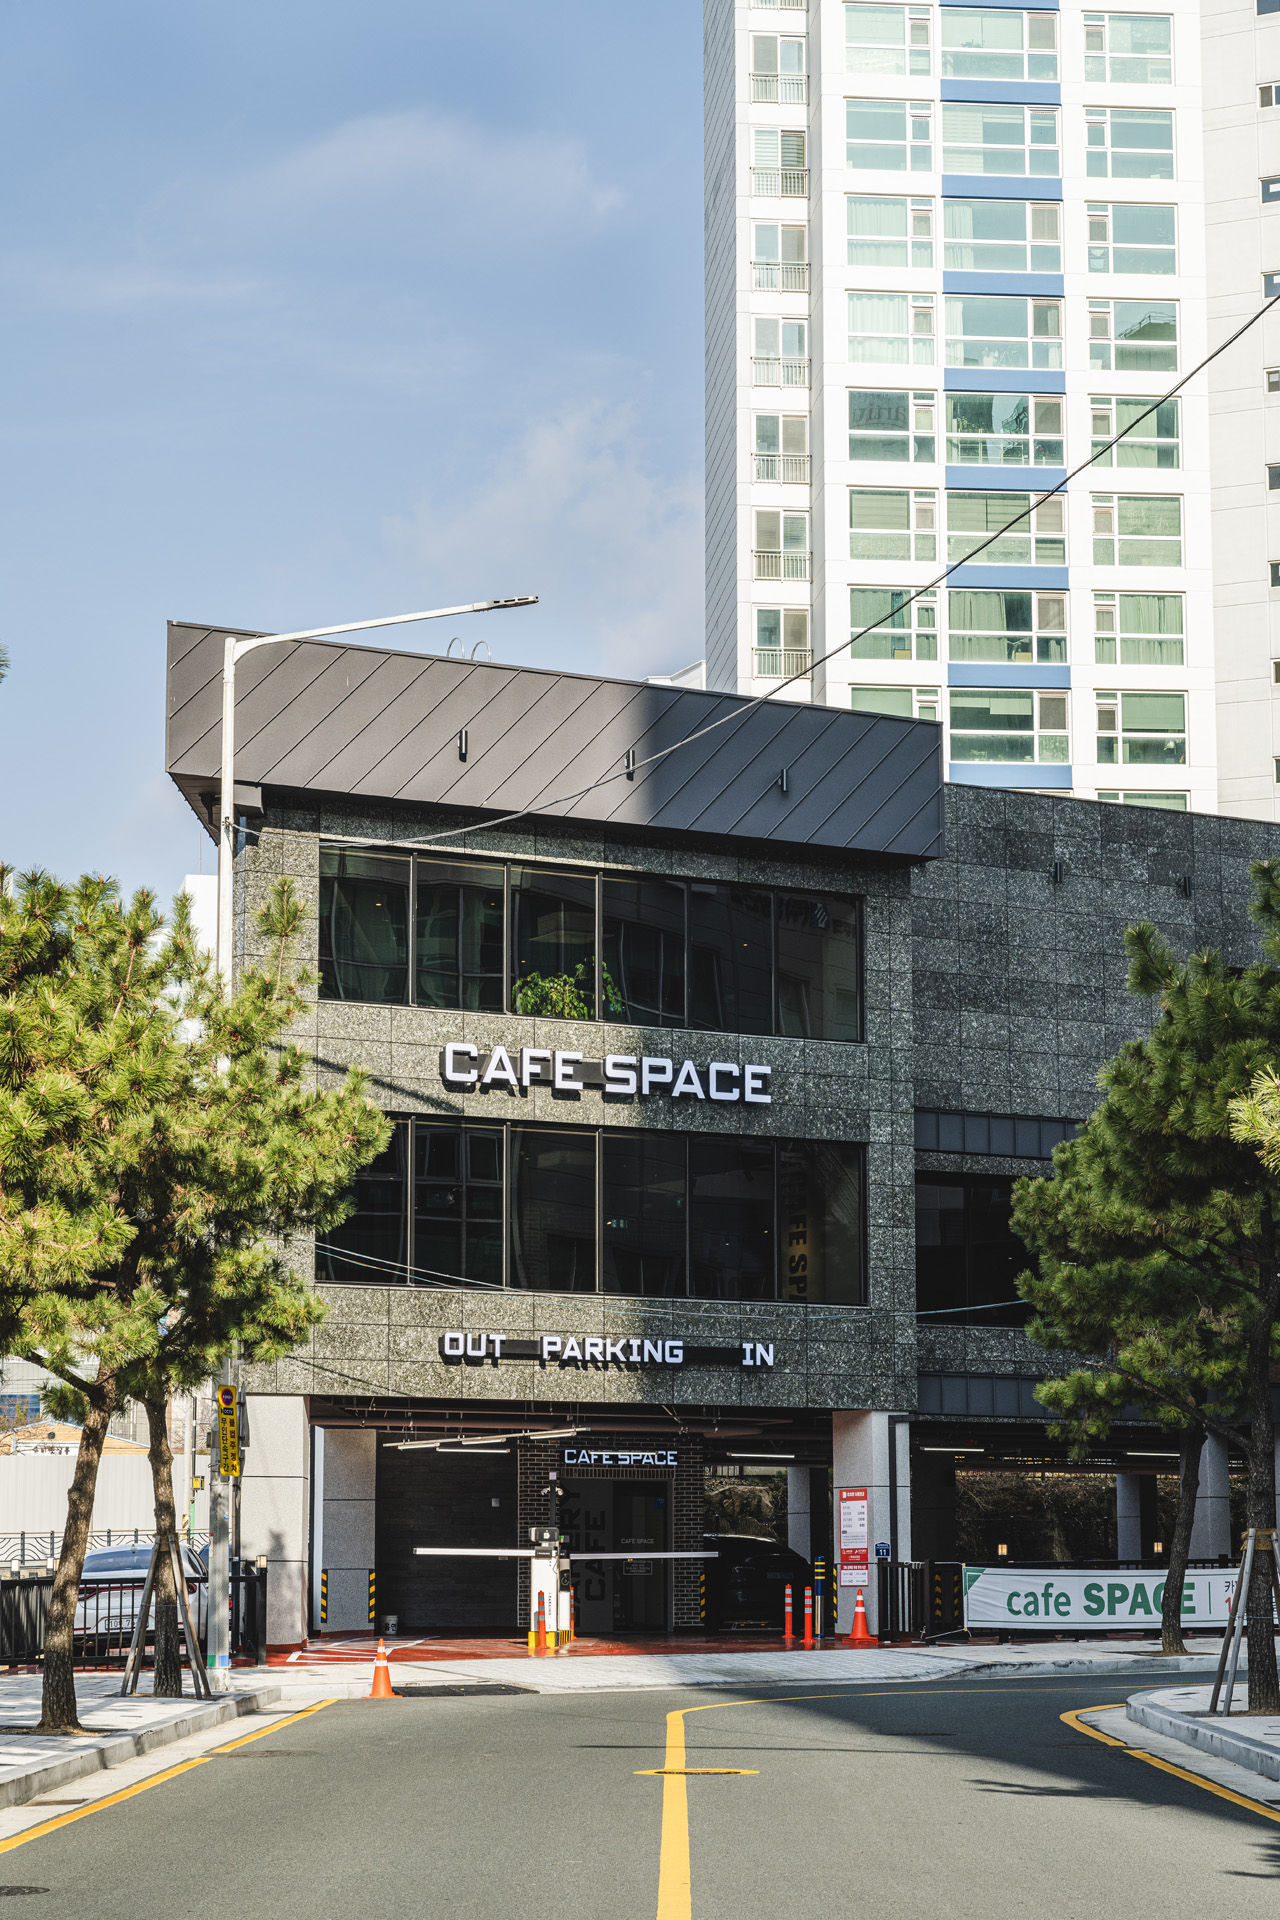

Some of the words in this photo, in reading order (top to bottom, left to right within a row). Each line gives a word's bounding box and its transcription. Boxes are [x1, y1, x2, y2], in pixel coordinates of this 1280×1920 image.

[443, 1041, 584, 1090] CAFE
[605, 1054, 771, 1104] SPACE
[444, 1331, 507, 1357] OUT
[542, 1335, 684, 1363] PARKING
[742, 1343, 774, 1366] IN
[221, 1418, 229, 1472] 무인단속구간
[229, 1418, 237, 1472] 불법주정차
[564, 1449, 613, 1464] CAFE
[618, 1450, 678, 1465] SPACE
[584, 1511, 605, 1601] CAFE
[1006, 1582, 1071, 1617] cafe
